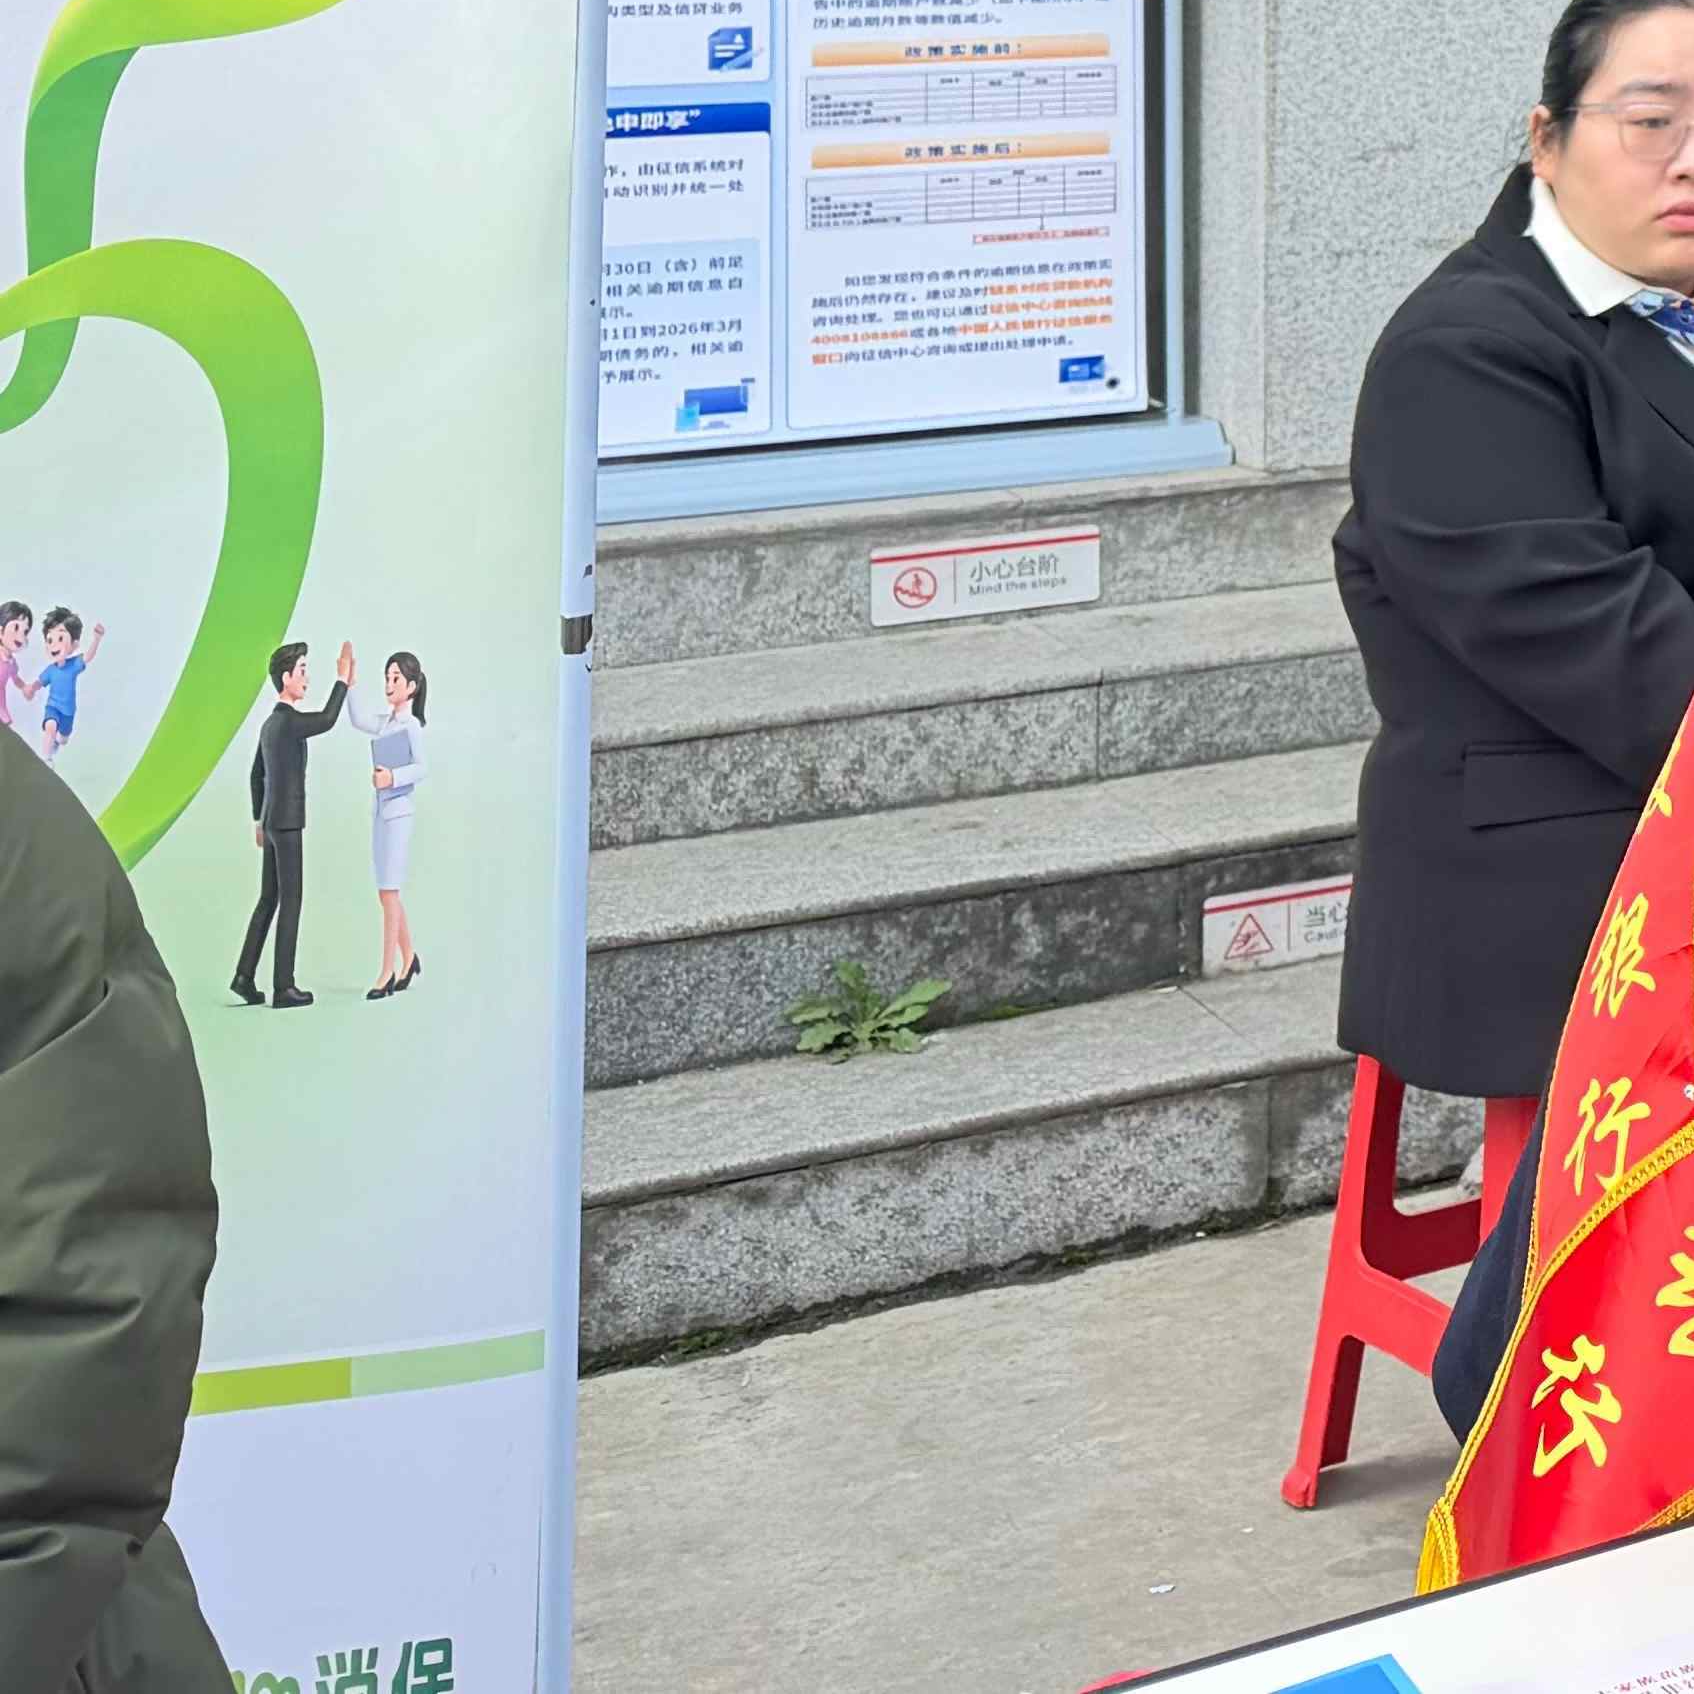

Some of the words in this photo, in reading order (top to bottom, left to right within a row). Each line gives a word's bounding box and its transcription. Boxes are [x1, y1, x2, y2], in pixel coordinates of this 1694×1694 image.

[970, 554, 1059, 582] 小心台阶
[968, 581, 1004, 597] Mind
[1008, 578, 1033, 594] the
